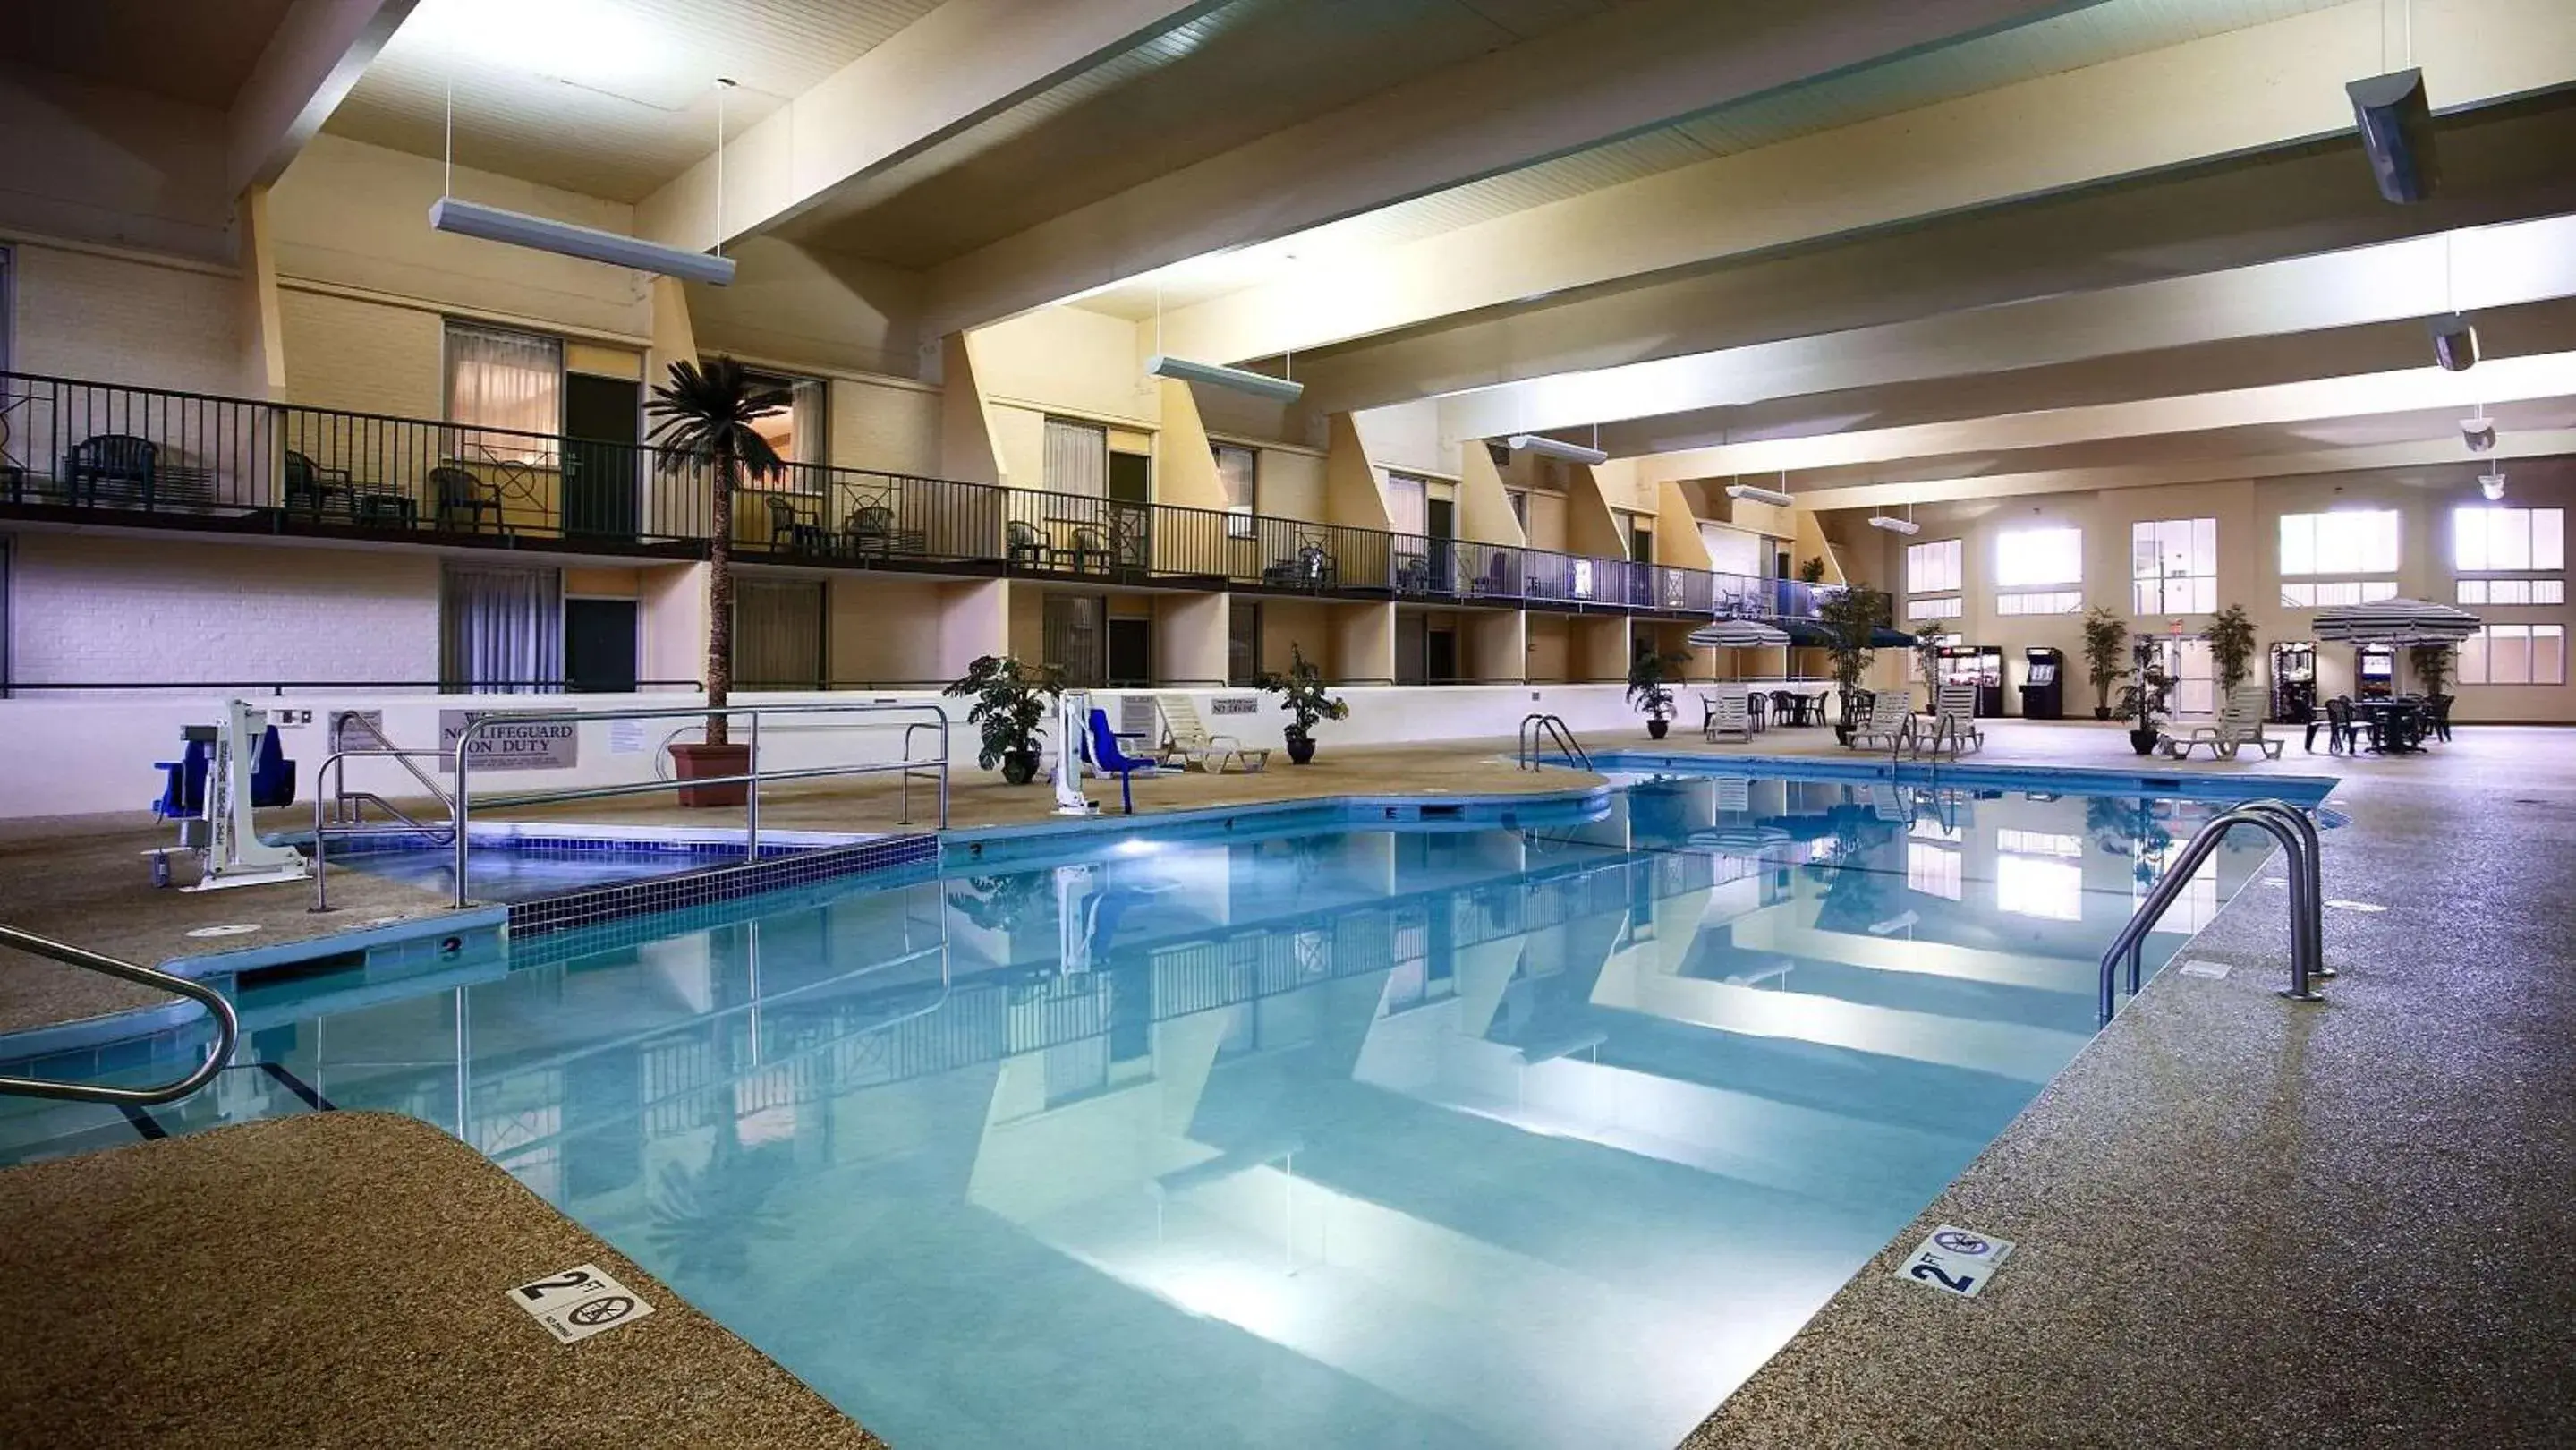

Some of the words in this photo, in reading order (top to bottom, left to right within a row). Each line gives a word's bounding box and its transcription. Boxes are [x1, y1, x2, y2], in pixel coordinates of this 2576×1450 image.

[480, 726, 573, 739] LIFEGUARD
[467, 740, 492, 753] ON
[502, 739, 550, 753] DUTY
[1920, 1252, 1944, 1267] FT
[1911, 1264, 1975, 1292] 2
[519, 1271, 590, 1301] 2
[578, 1280, 606, 1292] FT
